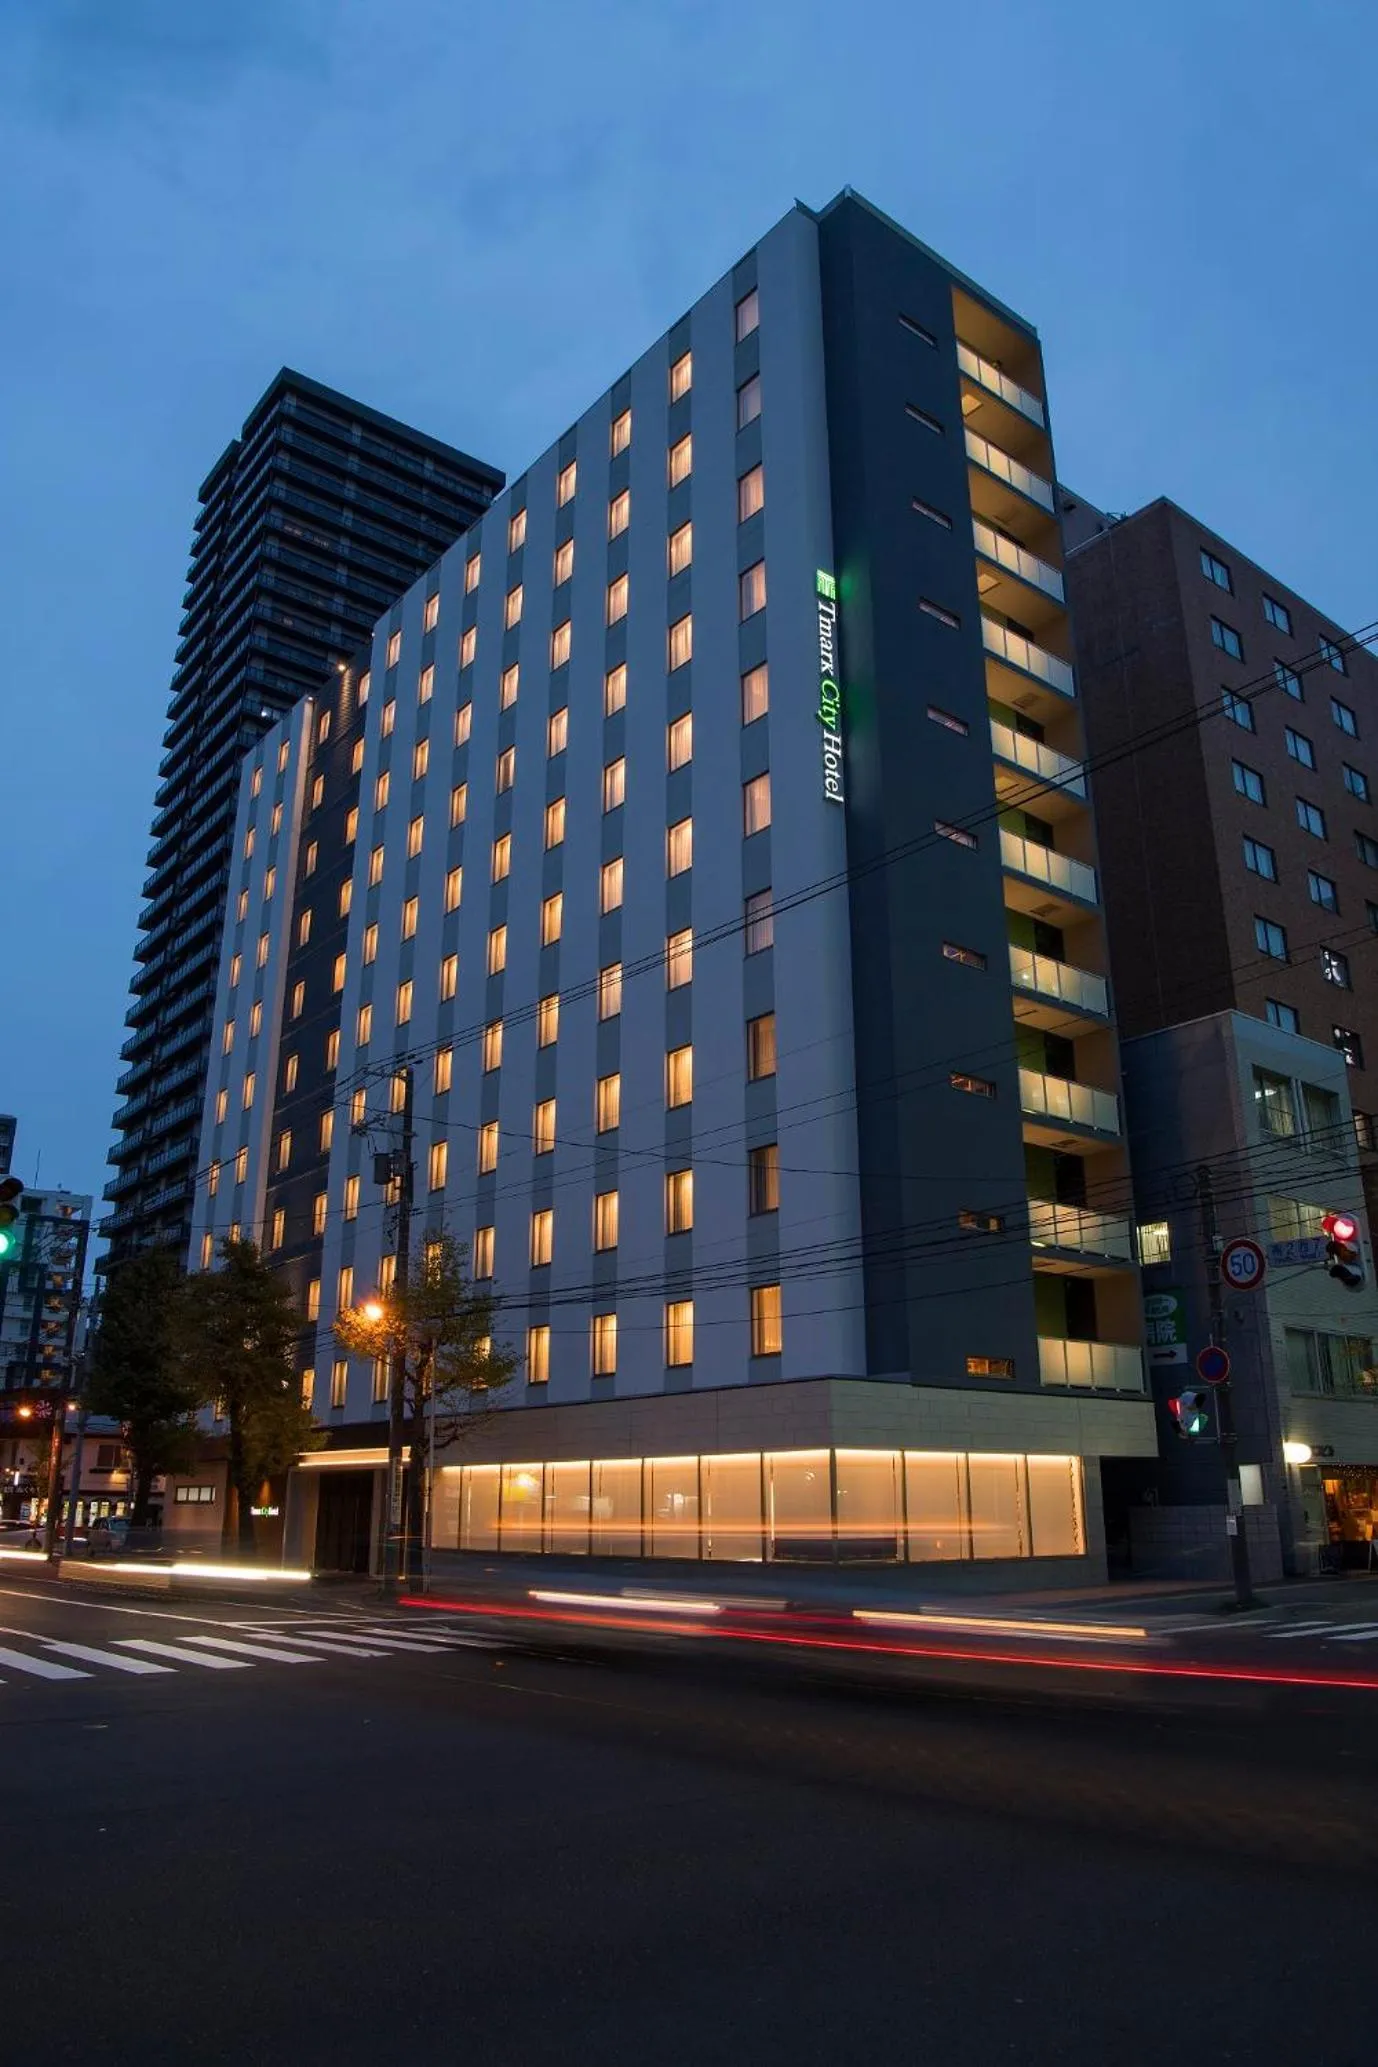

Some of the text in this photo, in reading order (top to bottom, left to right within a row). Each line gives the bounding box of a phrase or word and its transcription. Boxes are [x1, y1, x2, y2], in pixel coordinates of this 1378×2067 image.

[817, 600, 844, 803] Tmark City Hotel
[1231, 1252, 1256, 1276] 50
